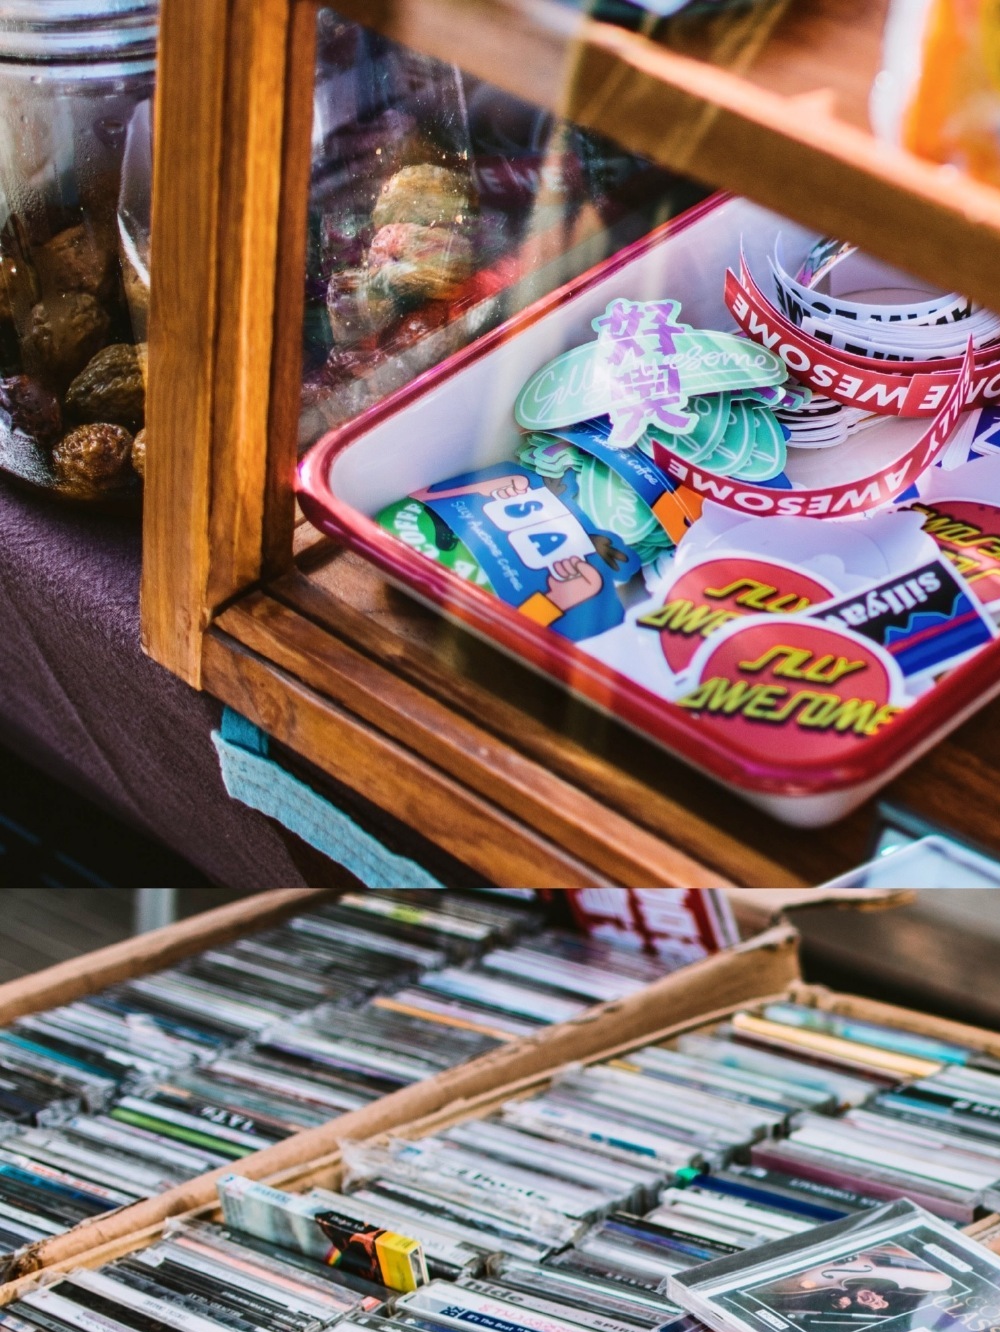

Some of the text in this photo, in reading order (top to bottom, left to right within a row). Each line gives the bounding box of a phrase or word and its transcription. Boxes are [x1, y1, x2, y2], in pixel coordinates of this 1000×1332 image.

[667, 458, 906, 517] AWESOME
[738, 644, 866, 686] SILLY
[674, 676, 904, 737] AWESOME
